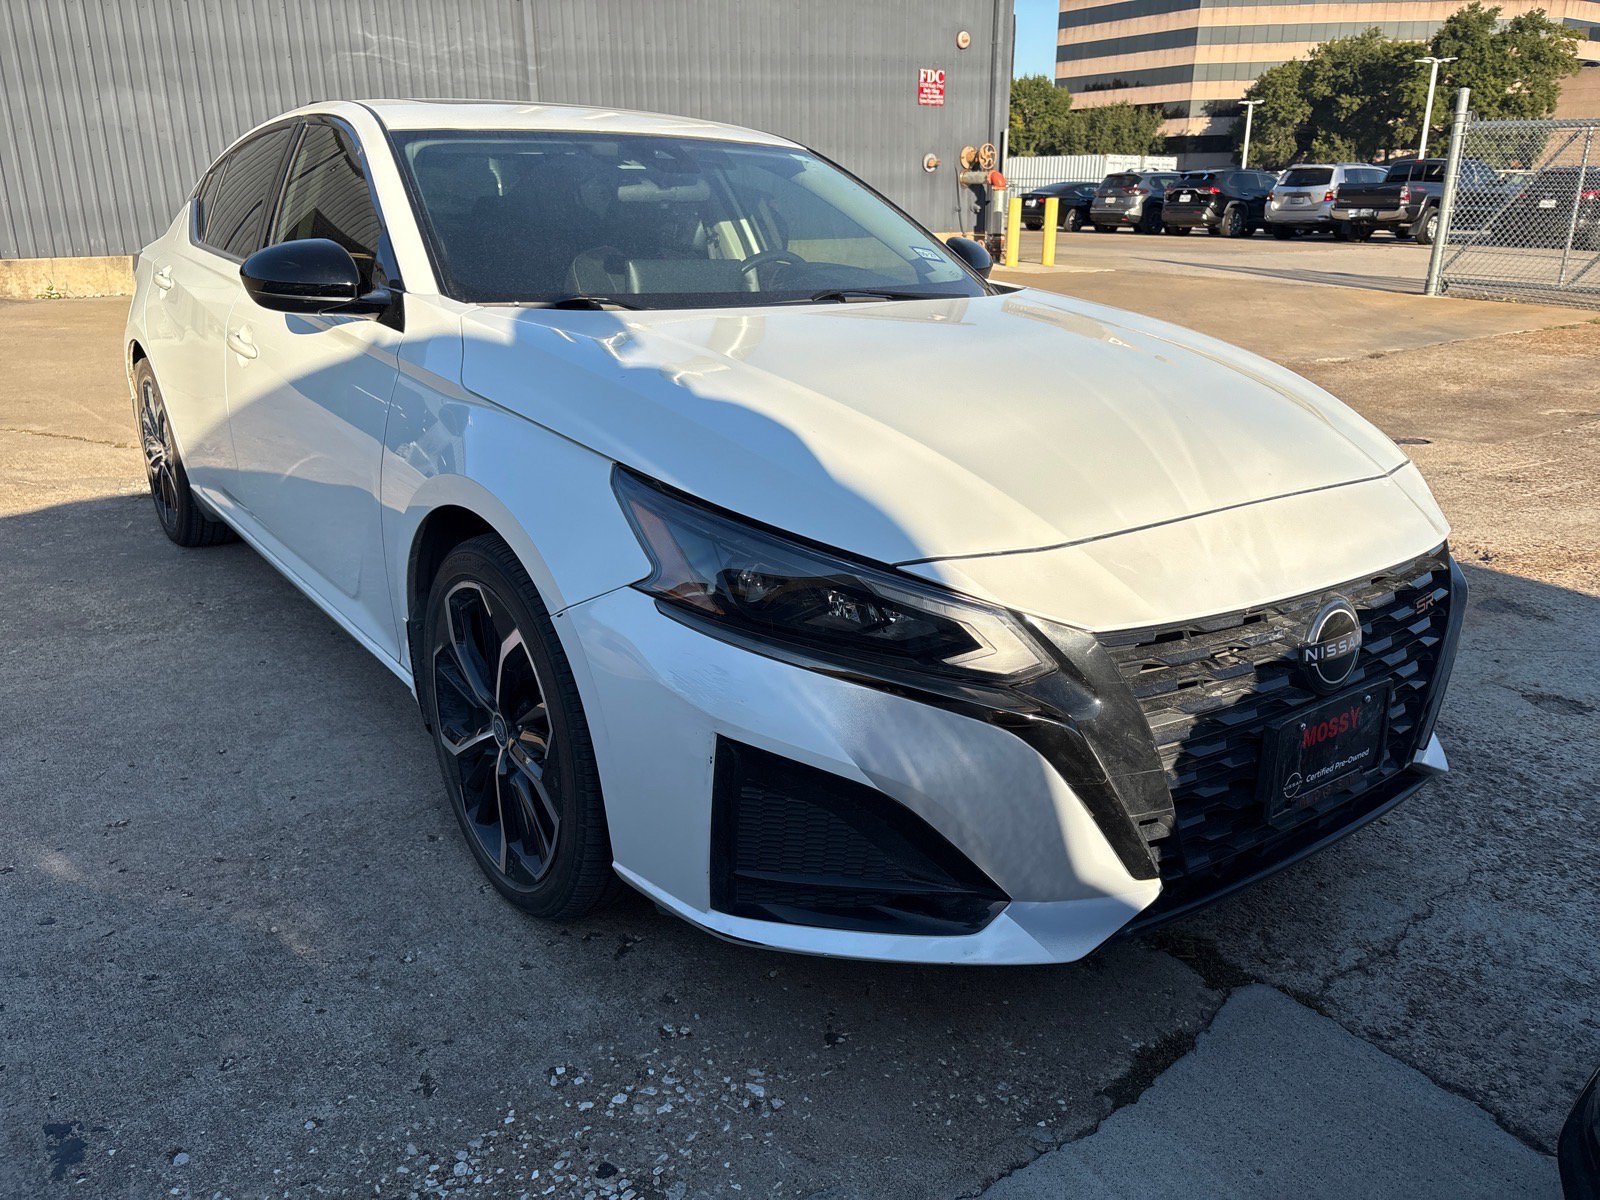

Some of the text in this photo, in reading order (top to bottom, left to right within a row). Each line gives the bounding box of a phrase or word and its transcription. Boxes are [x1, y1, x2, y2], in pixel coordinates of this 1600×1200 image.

[919, 68, 945, 83] FDC
[1416, 593, 1434, 614] SR
[1301, 706, 1361, 749] MOSSY
[1306, 747, 1370, 783] Certified Pre-Owned
